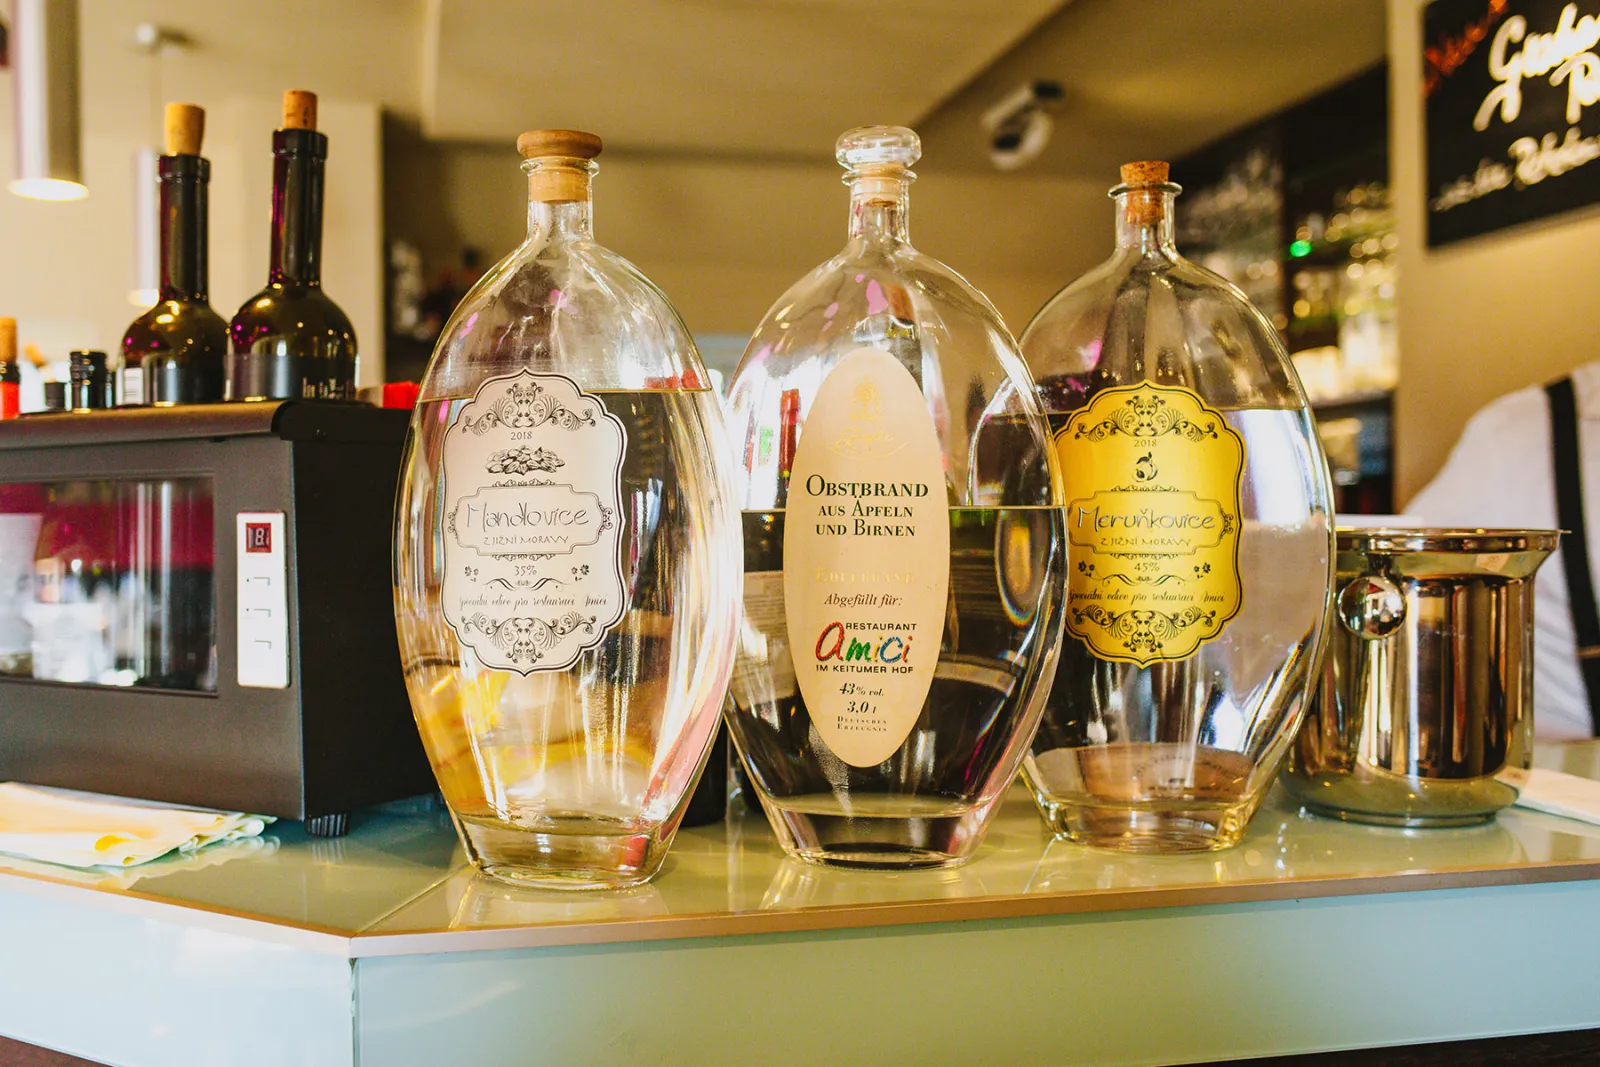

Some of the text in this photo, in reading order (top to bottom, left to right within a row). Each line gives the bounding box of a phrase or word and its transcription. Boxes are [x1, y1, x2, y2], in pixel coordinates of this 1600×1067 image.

[510, 431, 533, 441] 2018
[1134, 439, 1158, 447] 2018
[805, 473, 929, 497] OBSTBRAND
[818, 505, 846, 517] AUS
[466, 502, 590, 533] Mandlovice
[1077, 505, 1216, 533] Meruňkovice
[815, 524, 847, 536] UND
[520, 535, 569, 545] MORAVY
[1141, 537, 1192, 547] MORAVY
[514, 565, 538, 576] 35%
[1134, 562, 1160, 572] 45%
[824, 593, 903, 608] Abgefüllt für:
[1130, 592, 1147, 605] pro
[513, 598, 529, 611] pro
[845, 622, 917, 631] RESTAURANT
[816, 664, 914, 674] IM KEITUMER HOF
[869, 688, 885, 697] vol.
